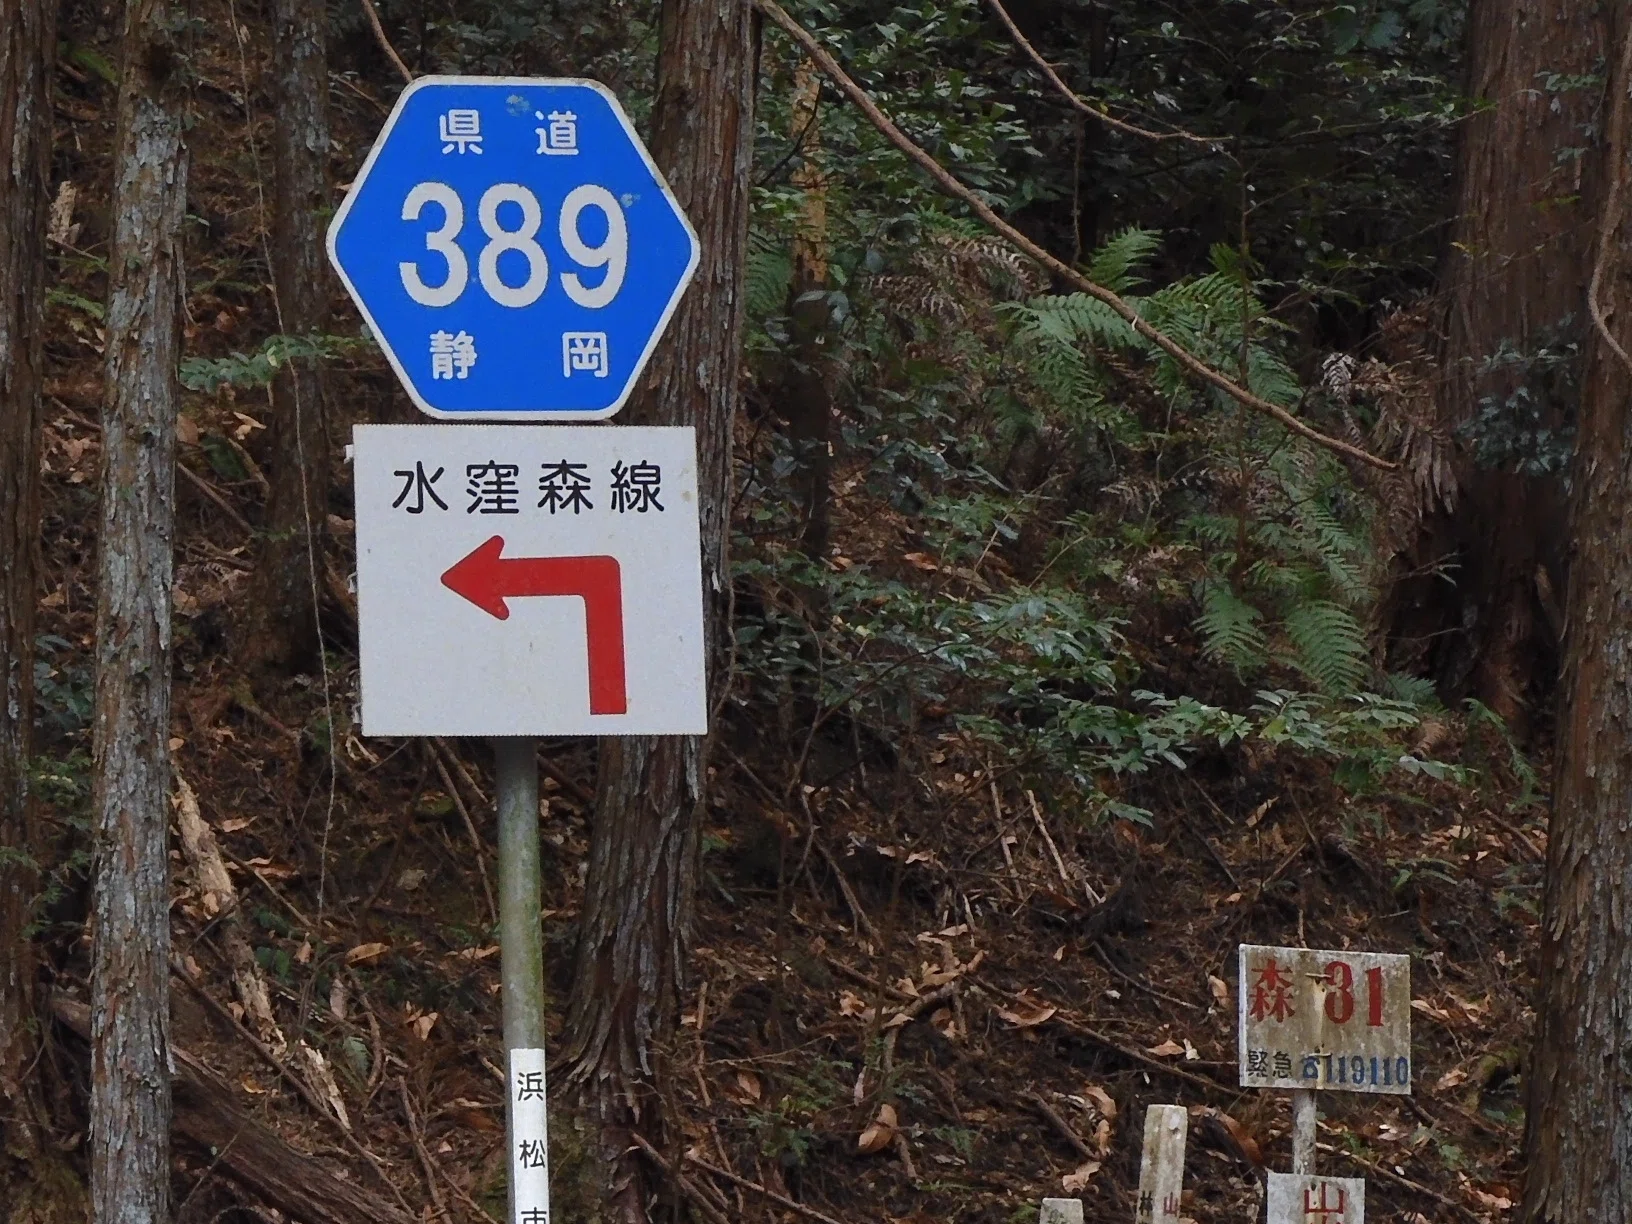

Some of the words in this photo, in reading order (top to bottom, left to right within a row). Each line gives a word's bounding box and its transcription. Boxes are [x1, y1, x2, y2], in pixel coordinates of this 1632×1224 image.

[439, 109, 579, 155] 県道
[399, 181, 628, 308] 389
[429, 330, 609, 380] 静岡
[392, 460, 666, 514] 水窪森線
[1248, 1051, 1292, 1078] 緊急
